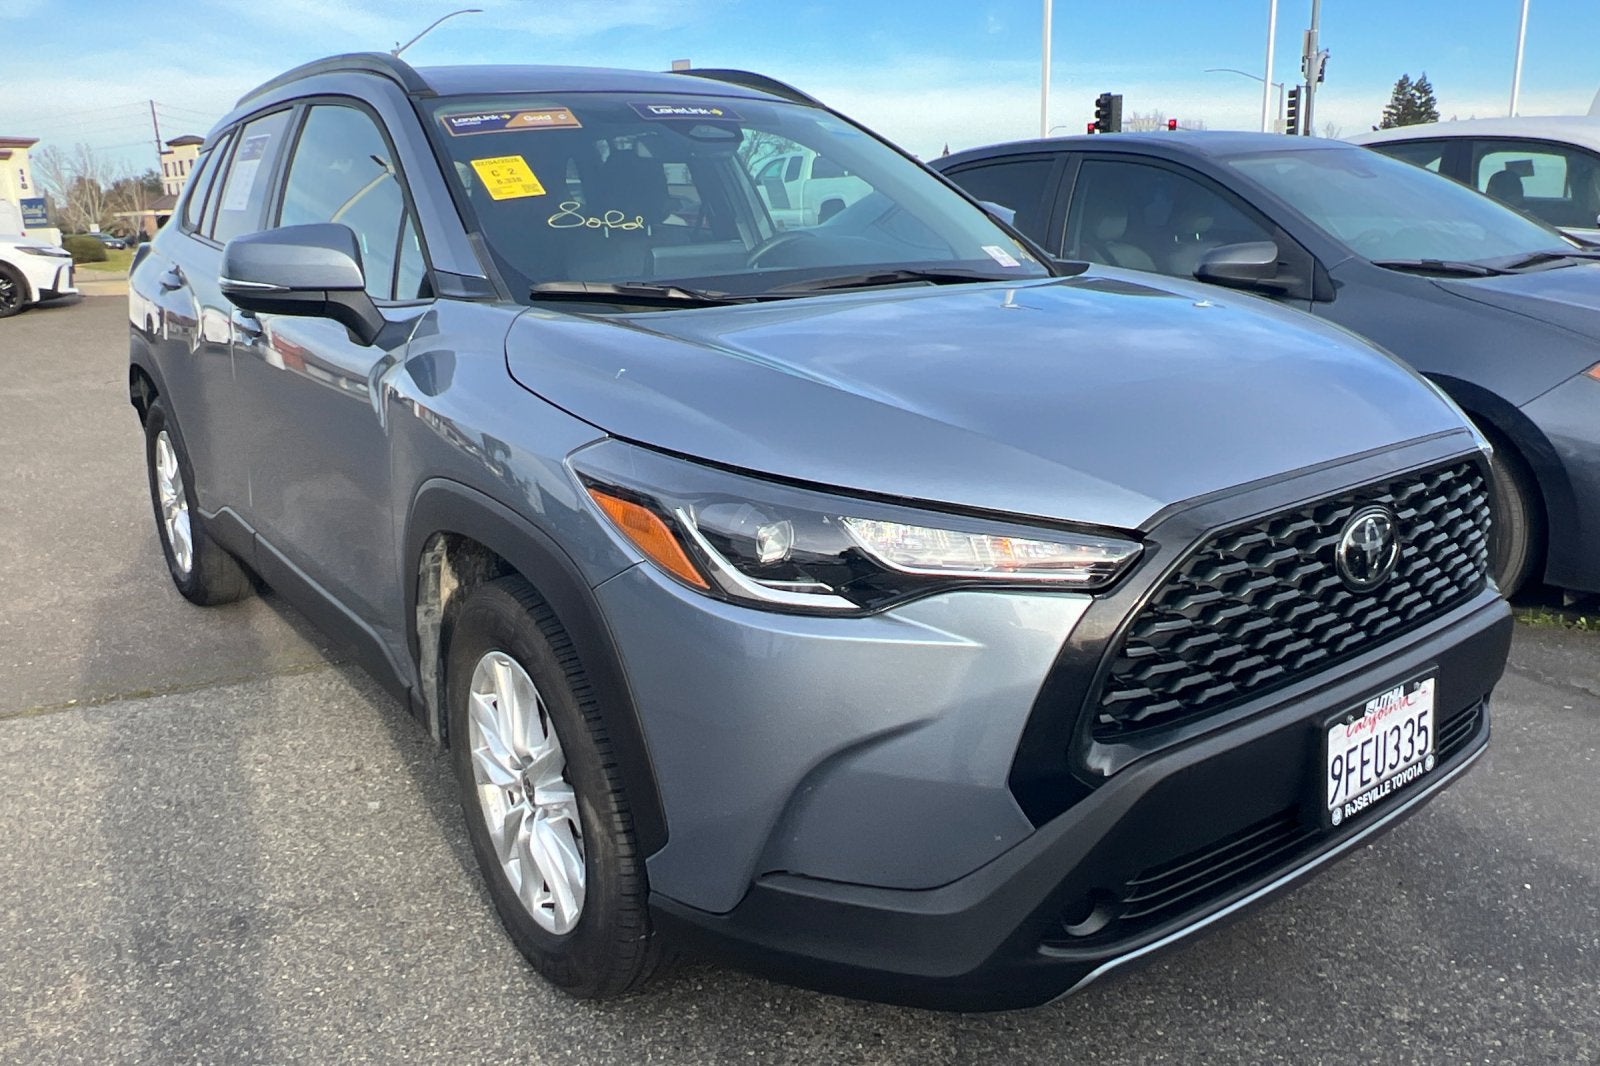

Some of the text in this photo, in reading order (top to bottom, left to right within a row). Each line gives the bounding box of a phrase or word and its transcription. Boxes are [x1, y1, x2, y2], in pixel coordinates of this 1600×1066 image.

[1329, 710, 1428, 806] 9FEU335
[1344, 762, 1424, 818] ROSEVILLE TOYOTA
